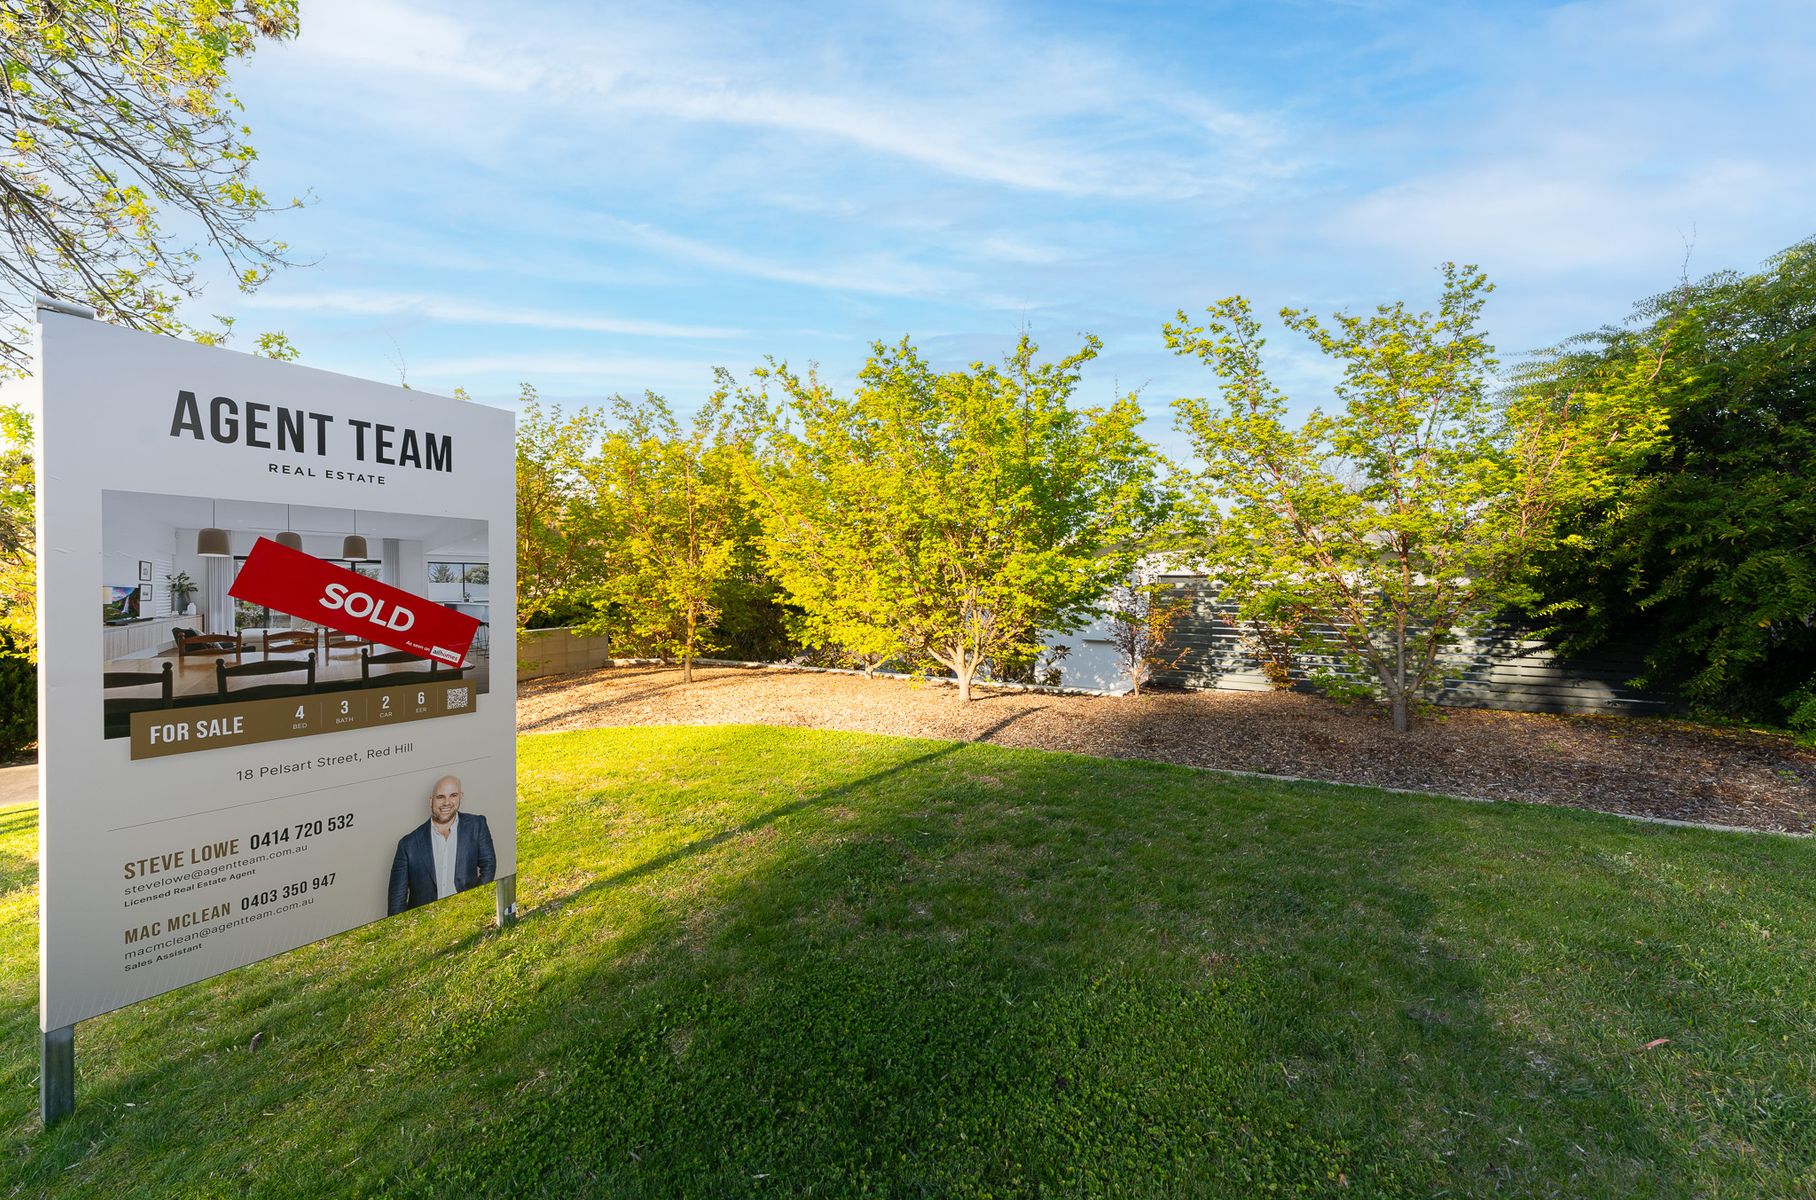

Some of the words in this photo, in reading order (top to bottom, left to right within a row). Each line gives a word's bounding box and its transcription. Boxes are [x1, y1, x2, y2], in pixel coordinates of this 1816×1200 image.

[170, 390, 333, 456] AGENT
[348, 418, 452, 473] TEAM
[268, 463, 316, 477] REAL
[325, 469, 386, 485] ESTATE
[319, 583, 415, 632] SOLD
[295, 705, 304, 720] 4
[341, 700, 349, 714] 3
[382, 695, 389, 709] 2
[417, 691, 425, 705] 6
[150, 721, 189, 745] FOR
[196, 716, 243, 738] SALE
[292, 722, 307, 730] BED
[236, 768, 254, 781] 18
[260, 759, 312, 778] Pelsart
[317, 751, 362, 768] Street,
[367, 746, 390, 759] Red
[394, 743, 413, 754] Hill
[124, 851, 185, 880] STEVE
[191, 838, 240, 864] LOWE
[250, 827, 290, 850] 0414
[294, 820, 322, 840] 720
[328, 813, 354, 832] 532
[124, 844, 308, 895] stevelowe@agentteam.com.au
[124, 889, 171, 908] Licensed
[173, 884, 194, 895] Real
[197, 877, 227, 889] Estate
[229, 869, 256, 882] Agent
[124, 921, 161, 945] MAC
[167, 902, 231, 932] MCLEAN
[241, 889, 277, 911] 0403
[282, 881, 308, 899] 350
[312, 872, 336, 890] 947
[124, 897, 314, 960] macmclean@agentteam.com.au
[124, 958, 153, 972] Sales
[156, 943, 202, 962] Assistant
